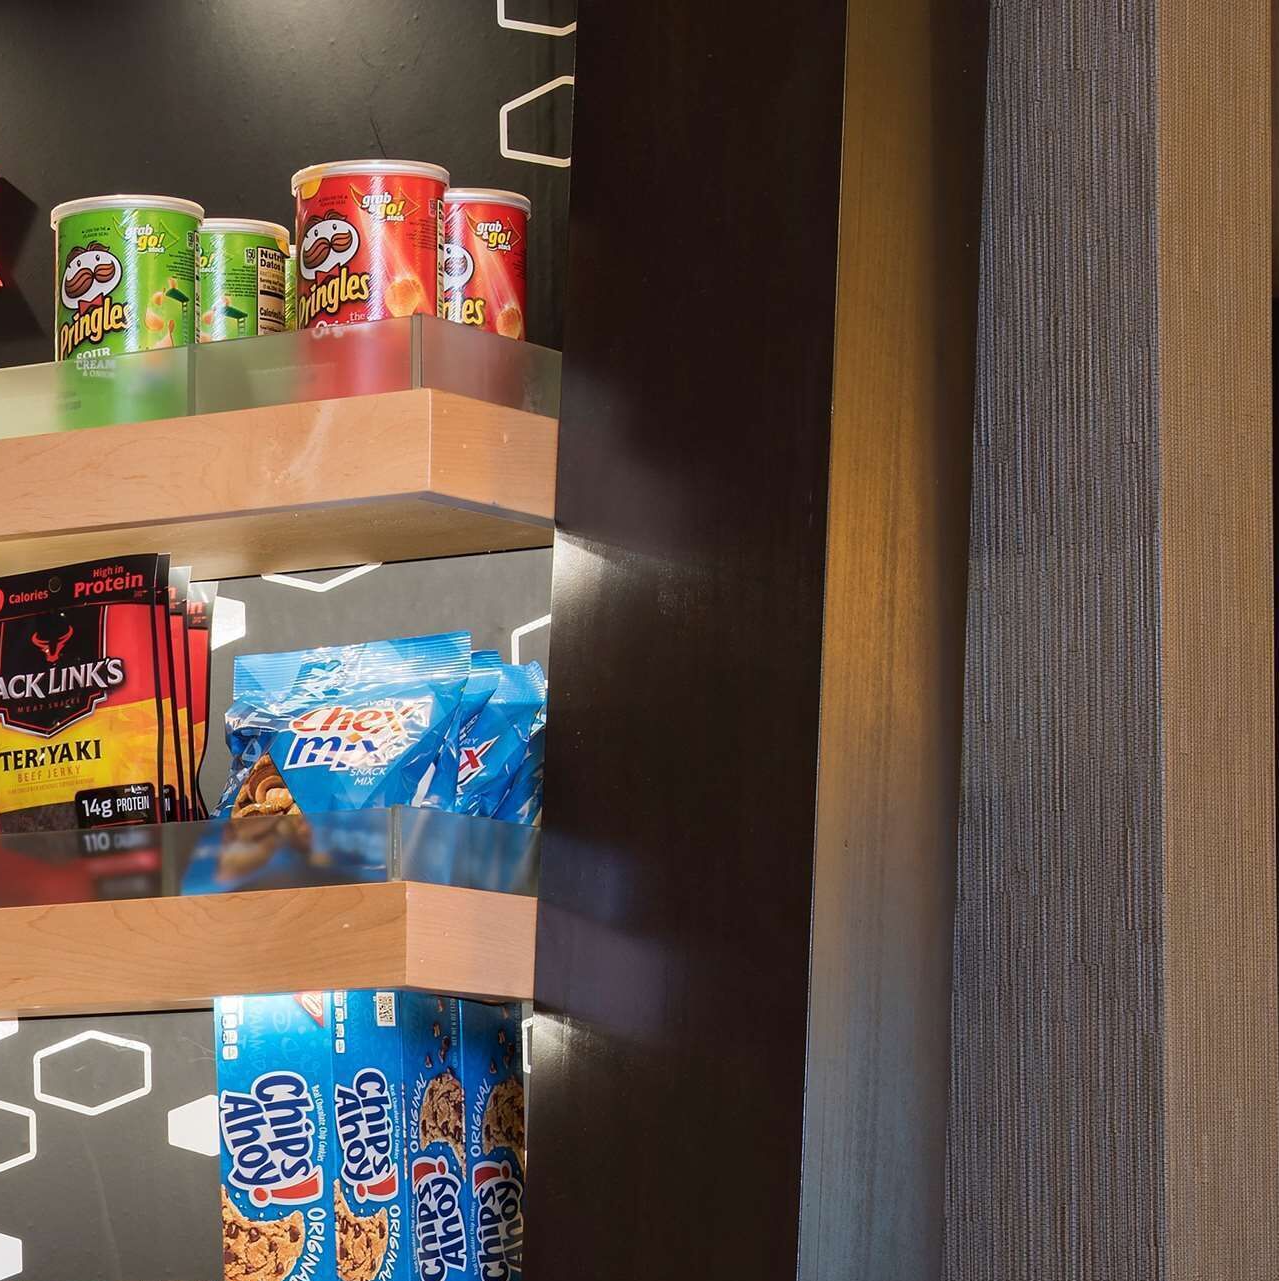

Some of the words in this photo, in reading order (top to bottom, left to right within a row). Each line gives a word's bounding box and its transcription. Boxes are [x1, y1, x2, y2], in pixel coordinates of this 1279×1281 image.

[476, 221, 502, 236] grab
[93, 567, 111, 578] High
[114, 565, 124, 574] in
[74, 573, 143, 598] Protein
[9, 589, 49, 605] Calories
[48, 657, 125, 697] LINK'S
[0, 740, 102, 772] TERIYAKI
[18, 773, 42, 783] BEEF
[47, 766, 81, 779] JERKY
[349, 767, 387, 777] SNACK
[354, 776, 375, 785] MIX
[82, 798, 113, 818] 14g
[116, 795, 150, 812] PROTEIN
[410, 1073, 427, 1153] ORIGINAL
[470, 1079, 491, 1157] ORIGINAL
